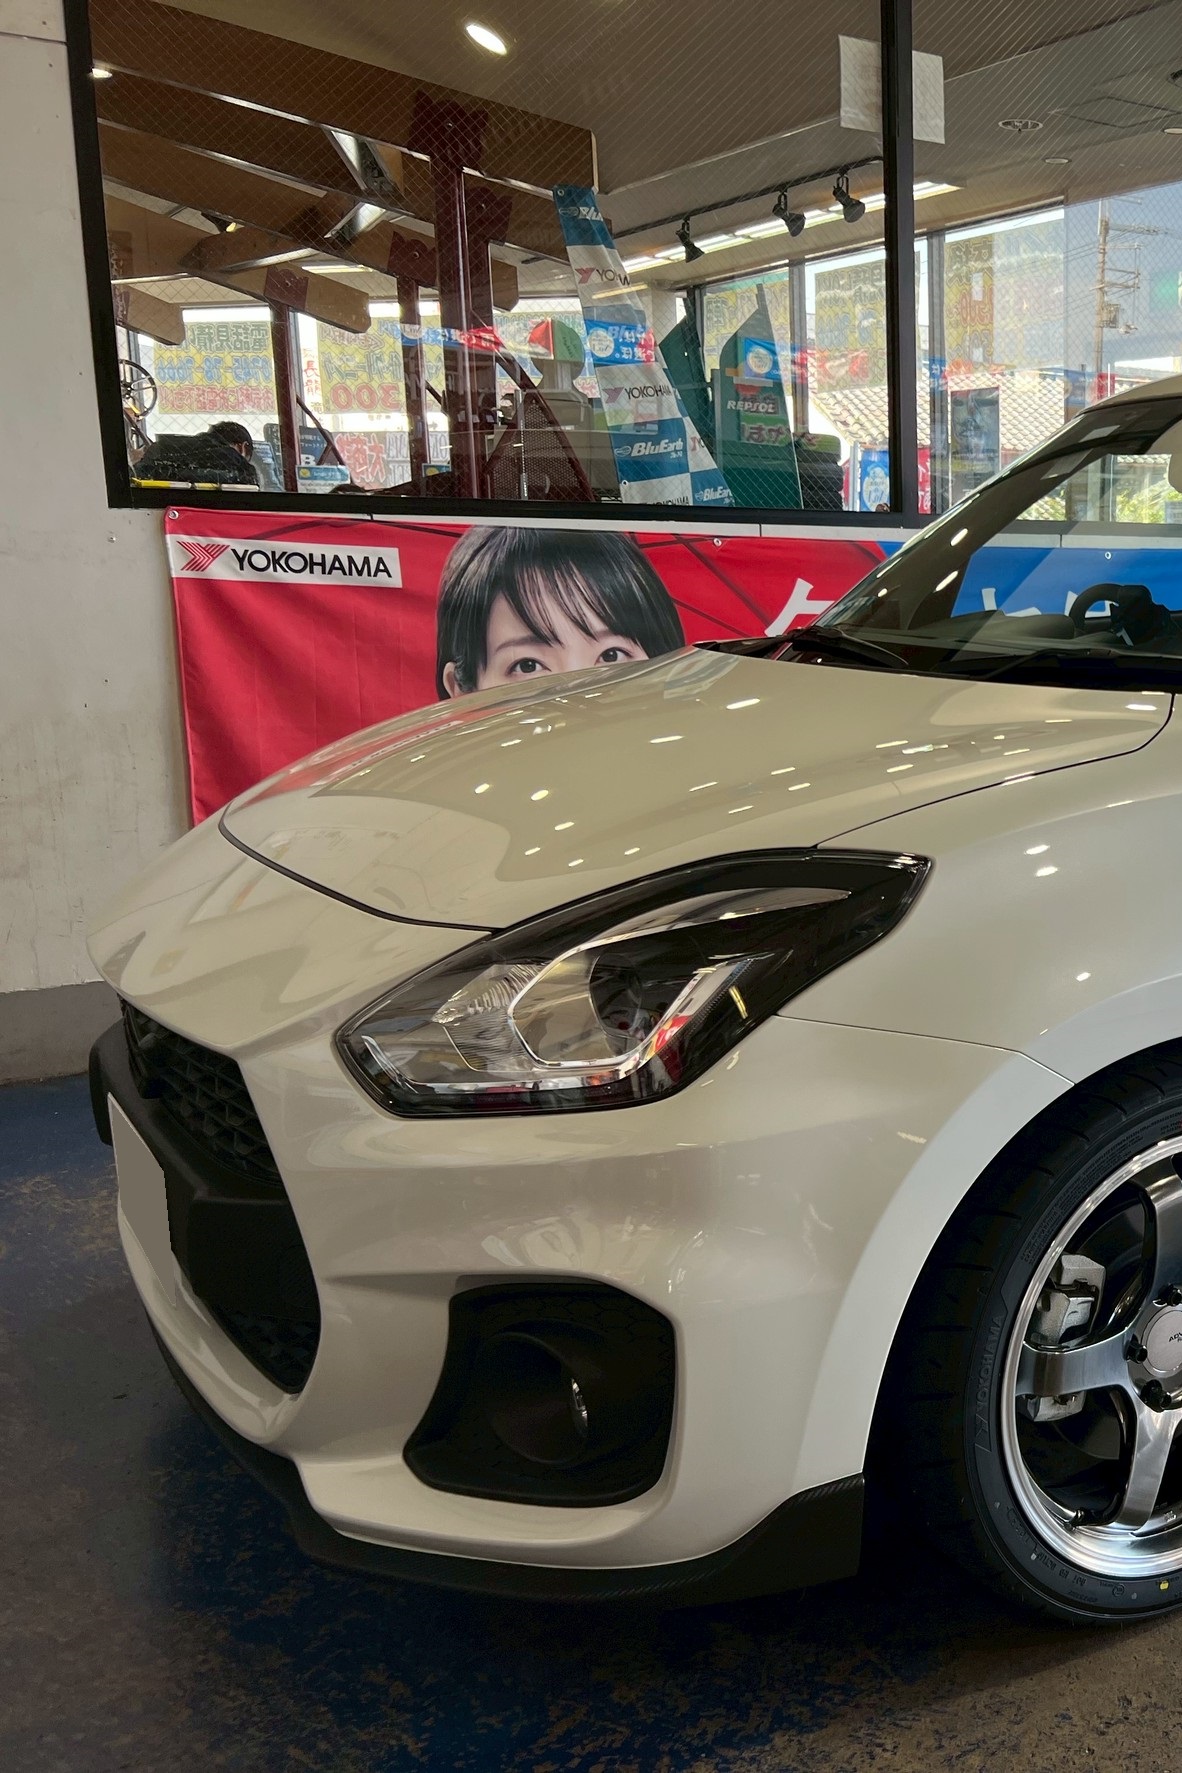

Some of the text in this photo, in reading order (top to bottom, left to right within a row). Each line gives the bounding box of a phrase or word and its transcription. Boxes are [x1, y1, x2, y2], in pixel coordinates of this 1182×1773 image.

[727, 400, 776, 413] REPSOL
[631, 438, 684, 457] BluEarth
[230, 546, 393, 579] YOKOHAMA
